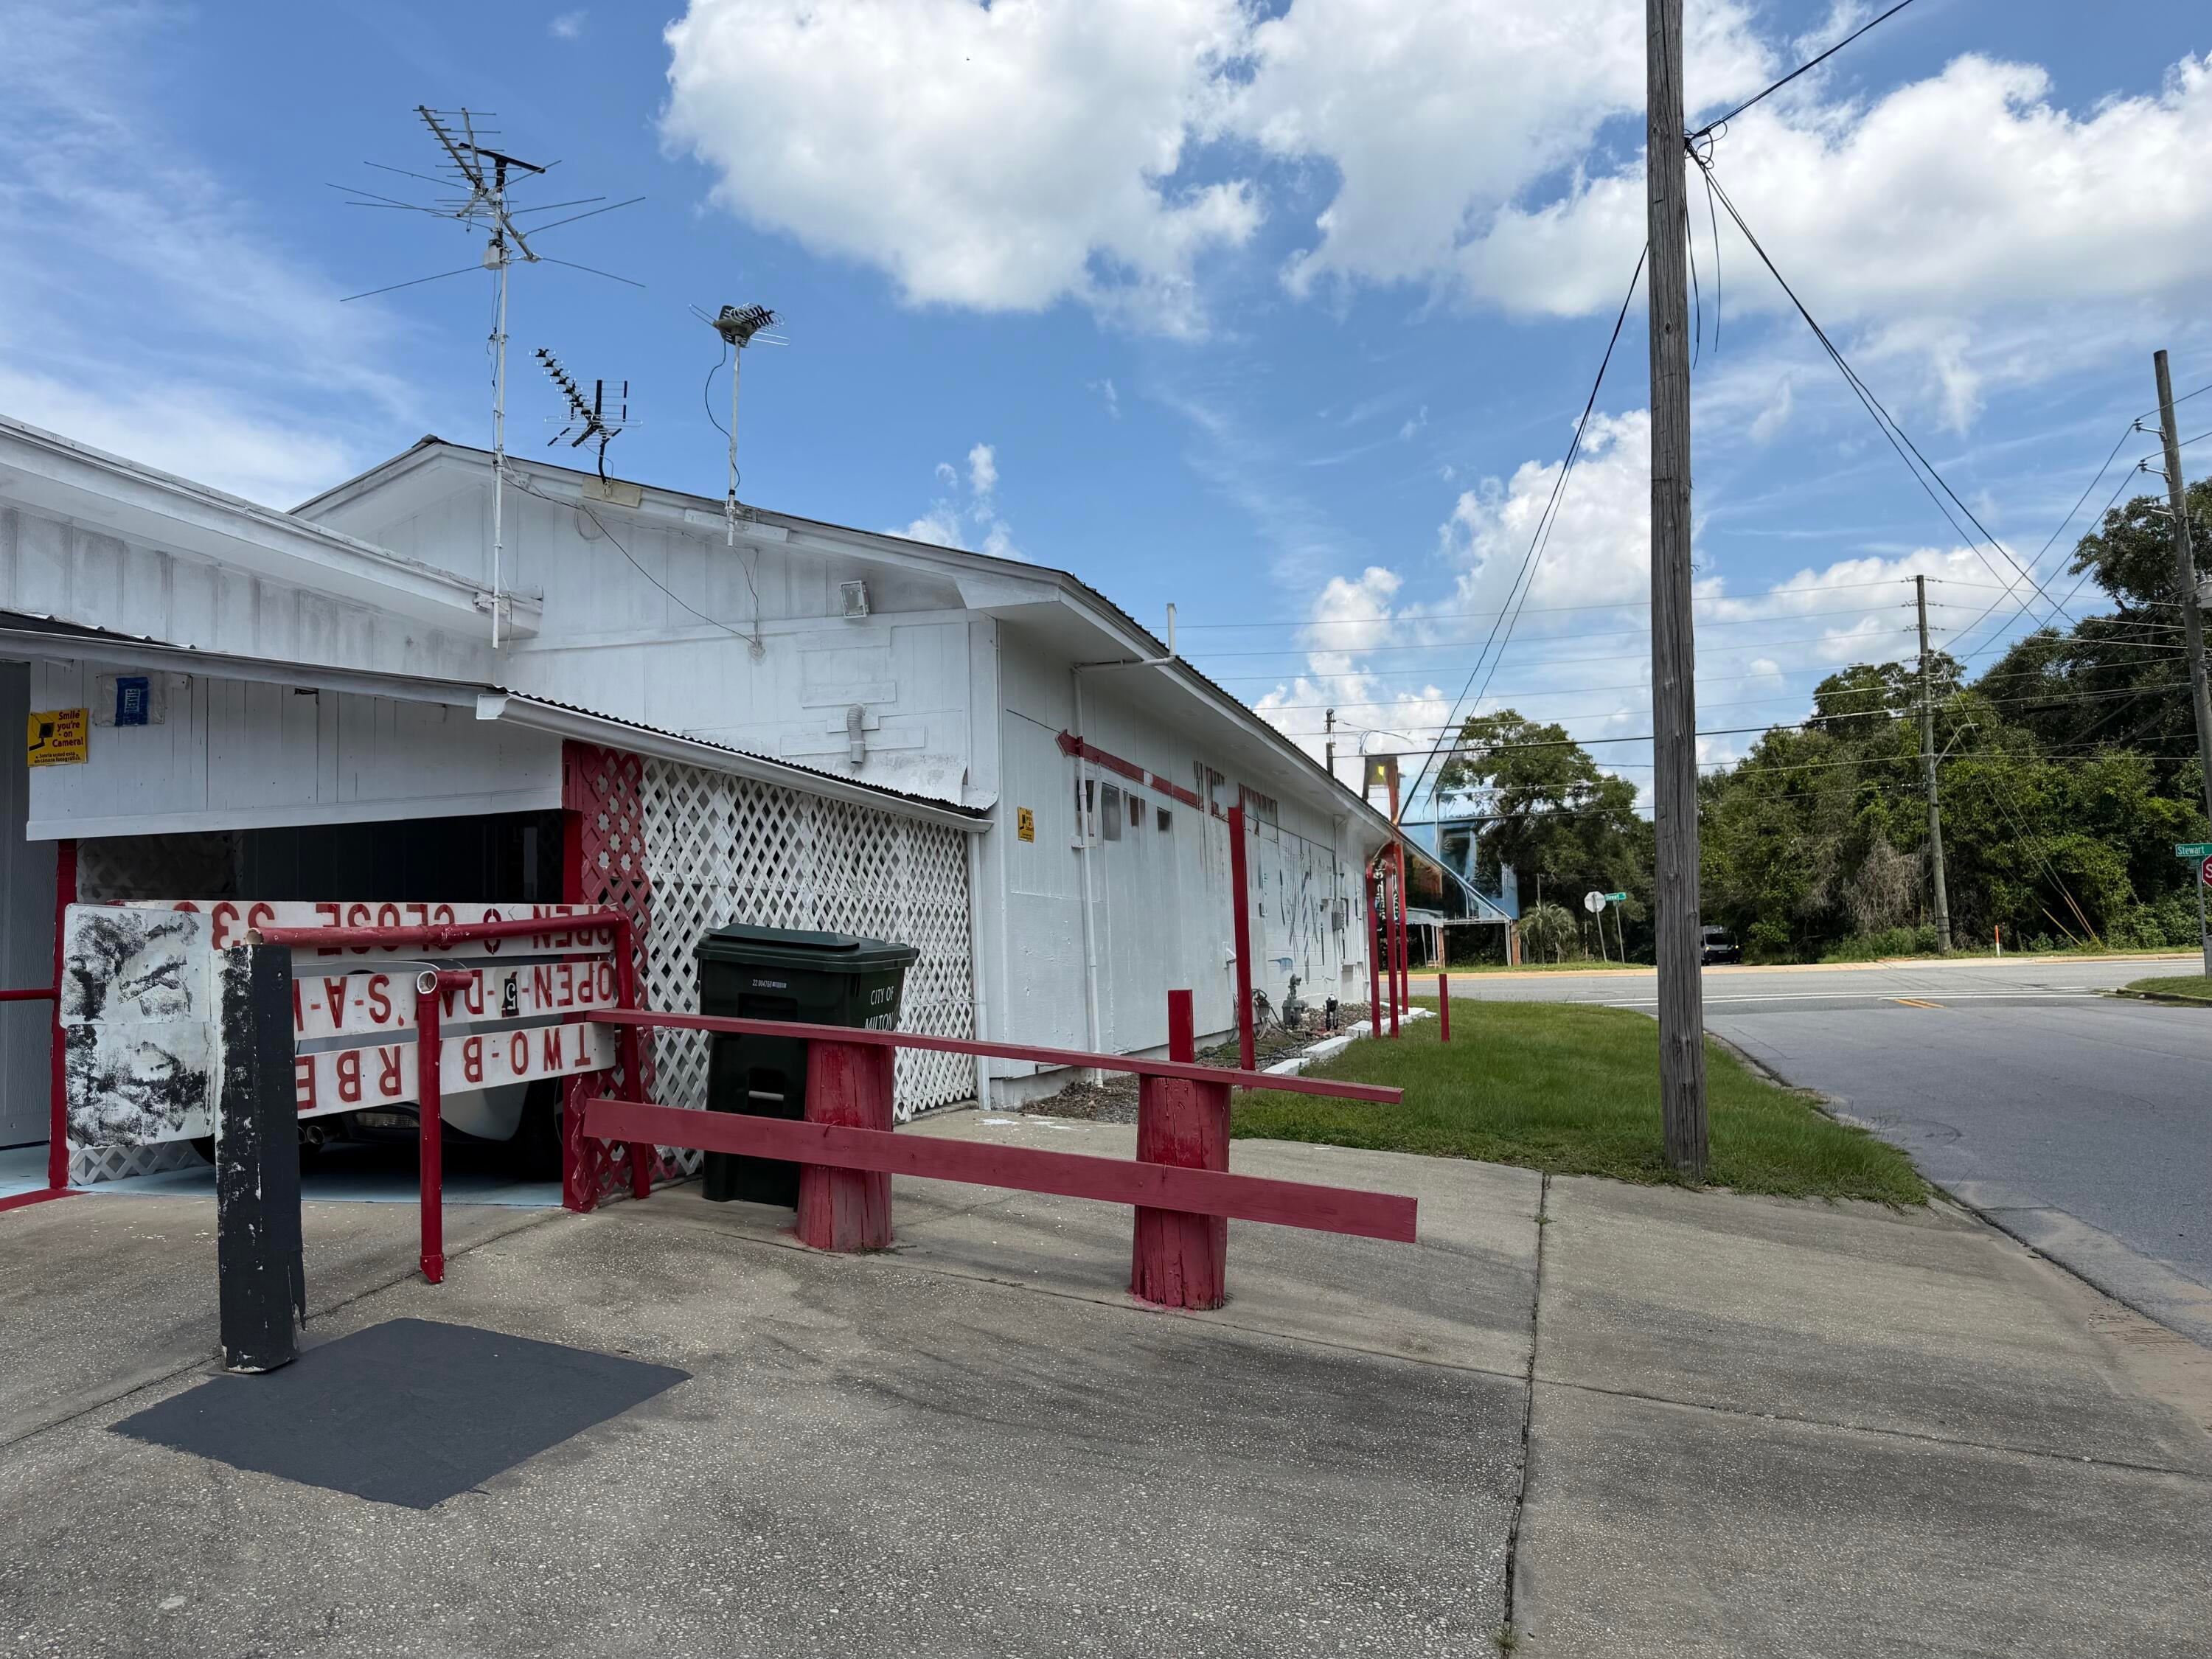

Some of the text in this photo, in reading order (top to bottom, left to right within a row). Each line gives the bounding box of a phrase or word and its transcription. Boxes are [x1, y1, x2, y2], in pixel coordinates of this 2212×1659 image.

[59, 710, 80, 720] Smile
[57, 720, 80, 732] you're
[2177, 845, 2205, 855] Stewart
[316, 902, 456, 956] CLOSE
[871, 986, 894, 1005] CITY OF
